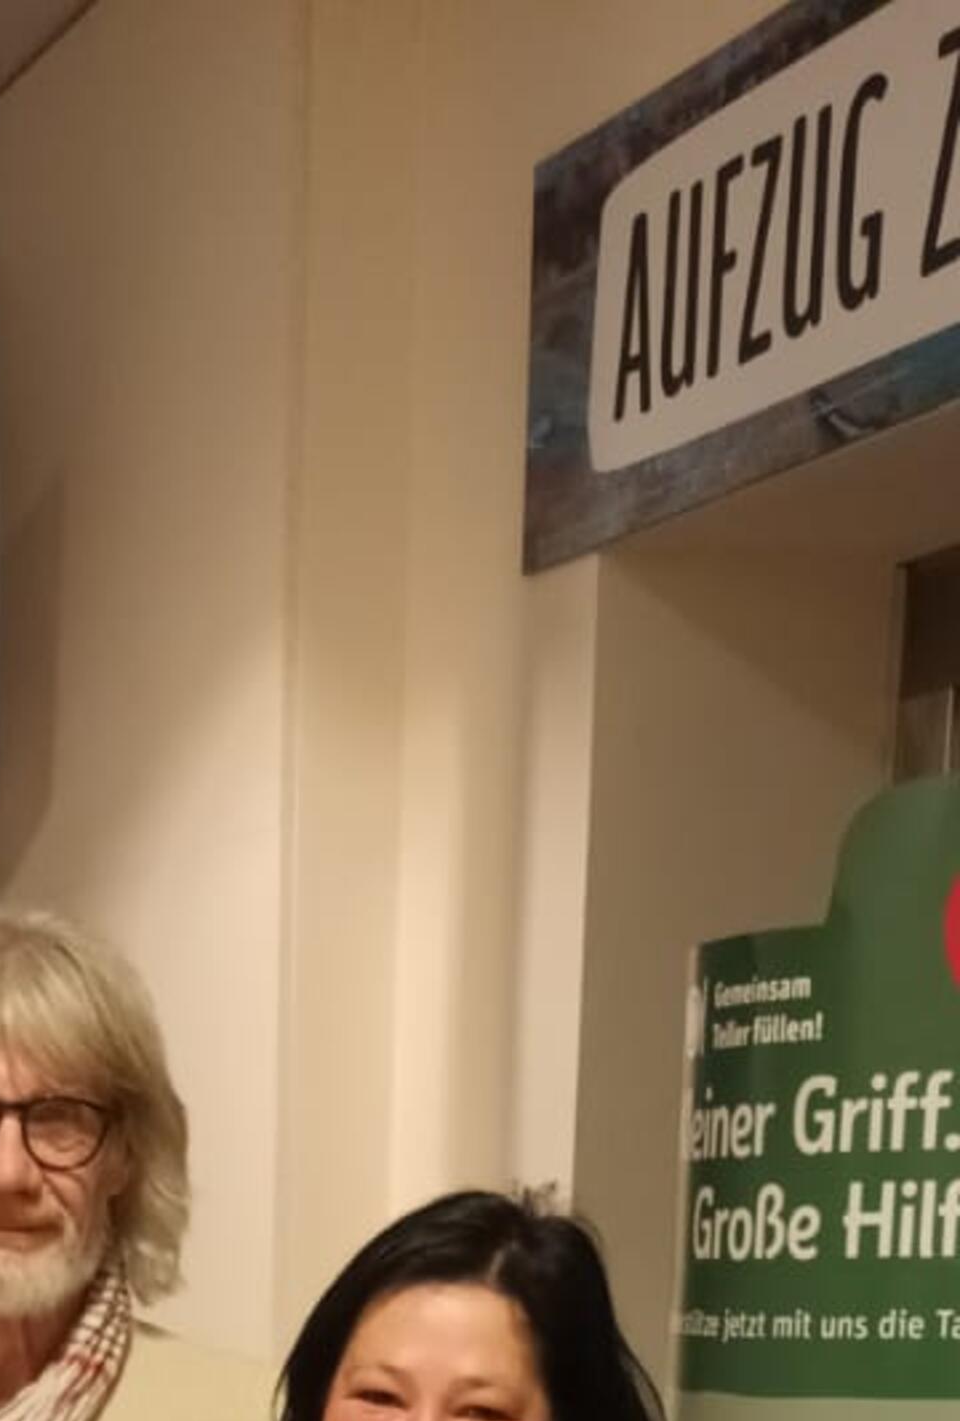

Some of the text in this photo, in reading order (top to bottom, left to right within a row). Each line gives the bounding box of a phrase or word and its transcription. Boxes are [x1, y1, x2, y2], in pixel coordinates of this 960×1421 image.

[614, 72, 889, 422] AUFZUG
[714, 976, 811, 1008] Gemeinsam
[713, 1011, 822, 1049] Teller füllen!
[794, 1070, 960, 1156] Griff.
[693, 1183, 821, 1261] Große
[722, 1308, 766, 1343] jetzt
[772, 1308, 811, 1338] mit
[821, 1313, 868, 1339] uns
[878, 1309, 925, 1339] die
